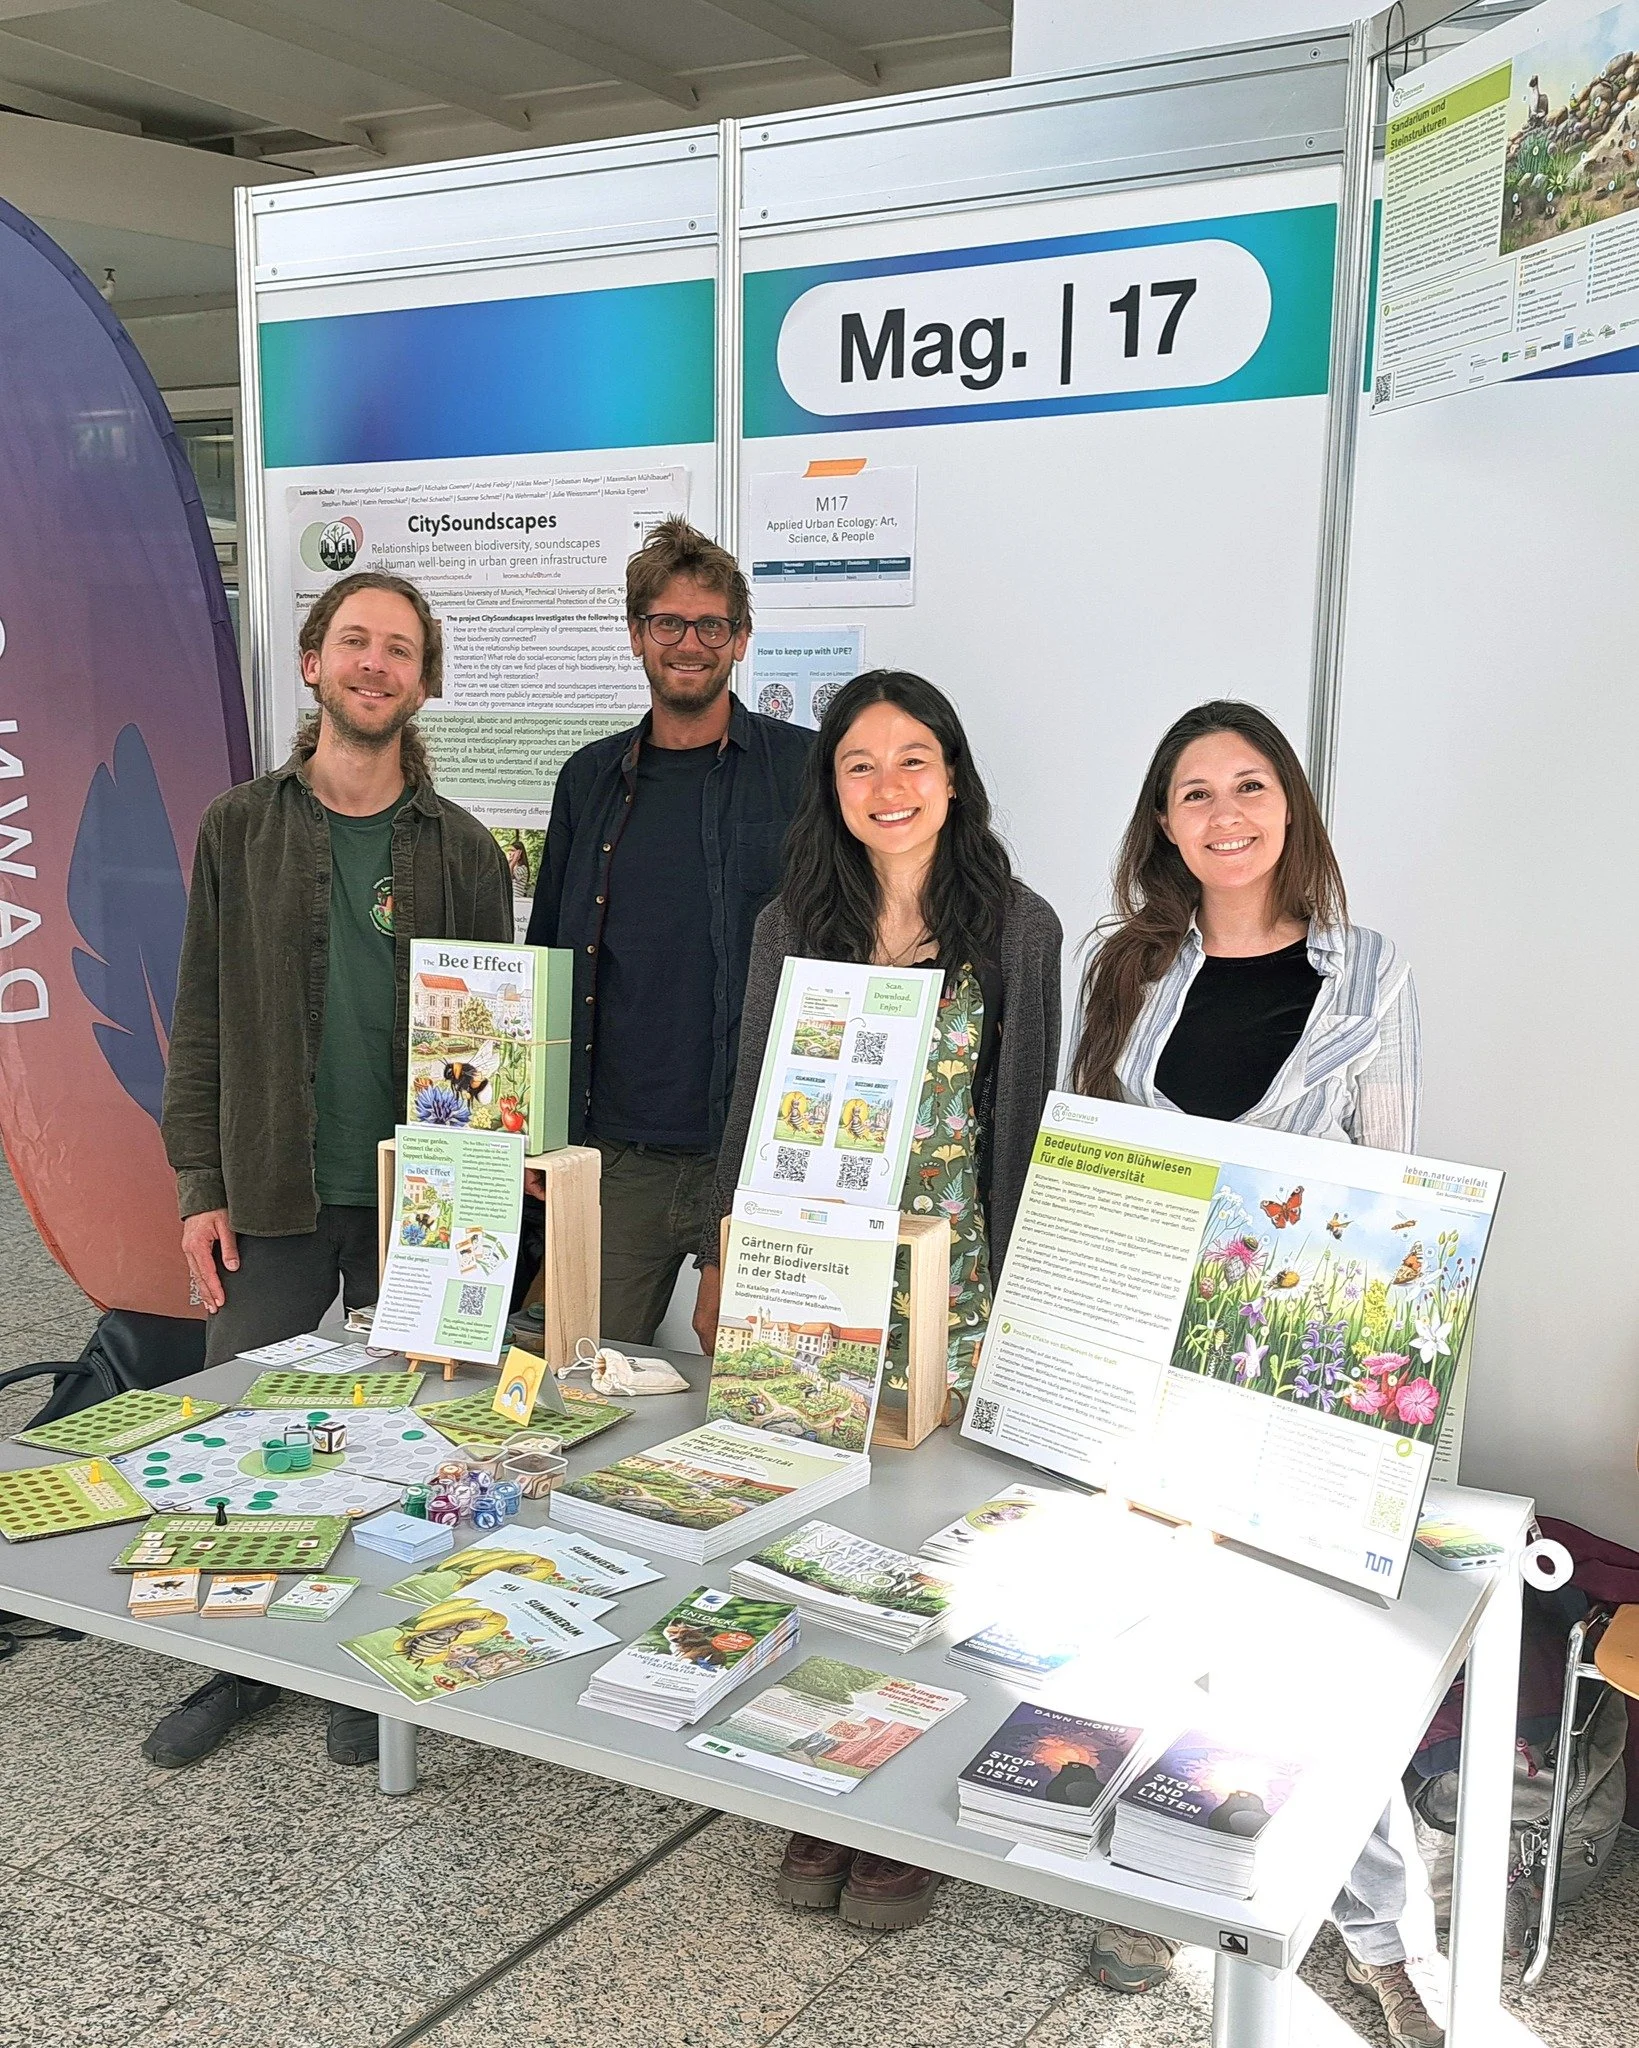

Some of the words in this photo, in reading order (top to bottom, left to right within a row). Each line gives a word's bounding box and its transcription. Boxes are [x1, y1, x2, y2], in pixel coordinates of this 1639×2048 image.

[1391, 111, 1430, 134] Sandarium
[1430, 99, 1447, 117] und
[1390, 117, 1448, 151] Steinstrukturen
[840, 308, 1027, 391] Mag.
[1109, 278, 1197, 358] 17
[816, 495, 849, 511] M17
[408, 511, 558, 537] CitySoundscapes
[766, 520, 803, 532] Applied
[805, 518, 834, 530] Urban
[837, 516, 878, 529] Ecology:
[880, 516, 899, 528] Art,
[371, 541, 430, 556] Relationships
[432, 541, 472, 552] between
[474, 539, 533, 553] biodiversity,
[535, 537, 601, 551] soundscapes
[789, 533, 830, 544] Science,
[832, 532, 840, 542] &
[842, 531, 875, 543] People
[366, 559, 384, 570] and
[385, 557, 416, 570] human
[418, 556, 466, 571] well-being
[468, 556, 477, 567] in
[479, 555, 507, 567] urban
[509, 557, 538, 569] green
[540, 553, 608, 566] infrastructure
[757, 647, 774, 656] How
[775, 647, 783, 656] to
[784, 648, 802, 657] keep
[803, 649, 814, 657] up
[815, 647, 831, 655] with
[832, 646, 853, 655] UPE?
[422, 958, 435, 967] The
[438, 952, 470, 969] Bee
[473, 955, 525, 974] Effect
[874, 991, 912, 1003] Download.
[885, 982, 905, 991] Scan.
[879, 1003, 903, 1014] Enjoy!
[1043, 1136, 1102, 1160] Bedeutung
[1104, 1149, 1125, 1162] von
[1126, 1153, 1193, 1177] Blühwiesen
[1039, 1151, 1056, 1166] für
[1057, 1156, 1074, 1169] die
[1076, 1159, 1147, 1184] Biodiversität
[1404, 1165, 1489, 1189] leben.natur.vielfalt
[868, 1218, 885, 1231] TUM
[741, 1235, 794, 1254] Gärtnern
[795, 1243, 814, 1256] für
[738, 1263, 749, 1275] in
[751, 1265, 772, 1279] der
[773, 1270, 807, 1284] Stadt
[739, 1250, 772, 1265] mehr
[773, 1257, 850, 1276] Biodiversität
[1364, 1550, 1394, 1577] TUM
[1034, 1708, 1072, 1724] DAWN
[1074, 1718, 1128, 1734] CHORUS
[981, 1759, 1021, 1775] AND
[989, 1750, 1036, 1769] STOP
[975, 1767, 1040, 1788] LISTEN
[1153, 1773, 1203, 1793] STOP
[1144, 1781, 1185, 1798] AND
[1137, 1787, 1203, 1814] LISTEN
